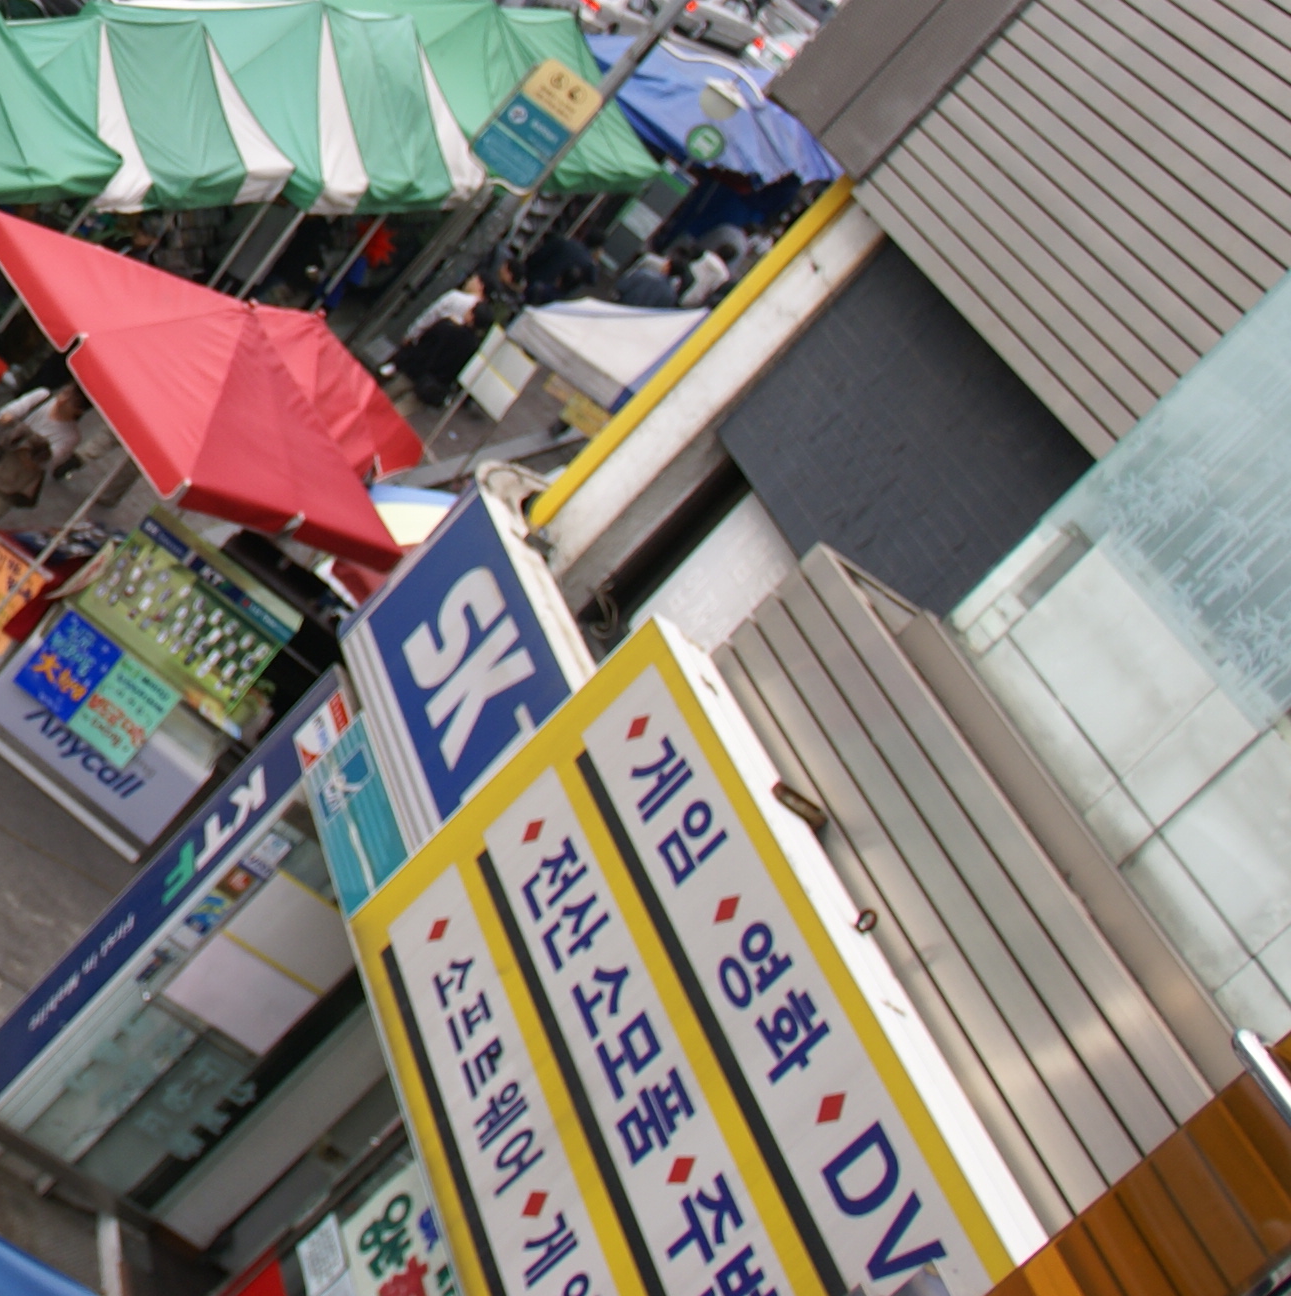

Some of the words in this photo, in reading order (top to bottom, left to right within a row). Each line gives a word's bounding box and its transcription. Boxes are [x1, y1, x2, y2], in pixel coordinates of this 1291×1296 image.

[399, 565, 538, 773] SK
[22, 706, 146, 799] Anycall
[162, 764, 266, 905] KTF
[81, 952, 99, 976] in
[99, 911, 137, 958] First
[627, 735, 731, 887] 게임
[714, 919, 831, 1087] 영화
[519, 836, 613, 973] 전산
[570, 959, 698, 1168] 소모품
[430, 952, 548, 1198] 소프트웨어
[357, 1192, 414, 1279] 용산
